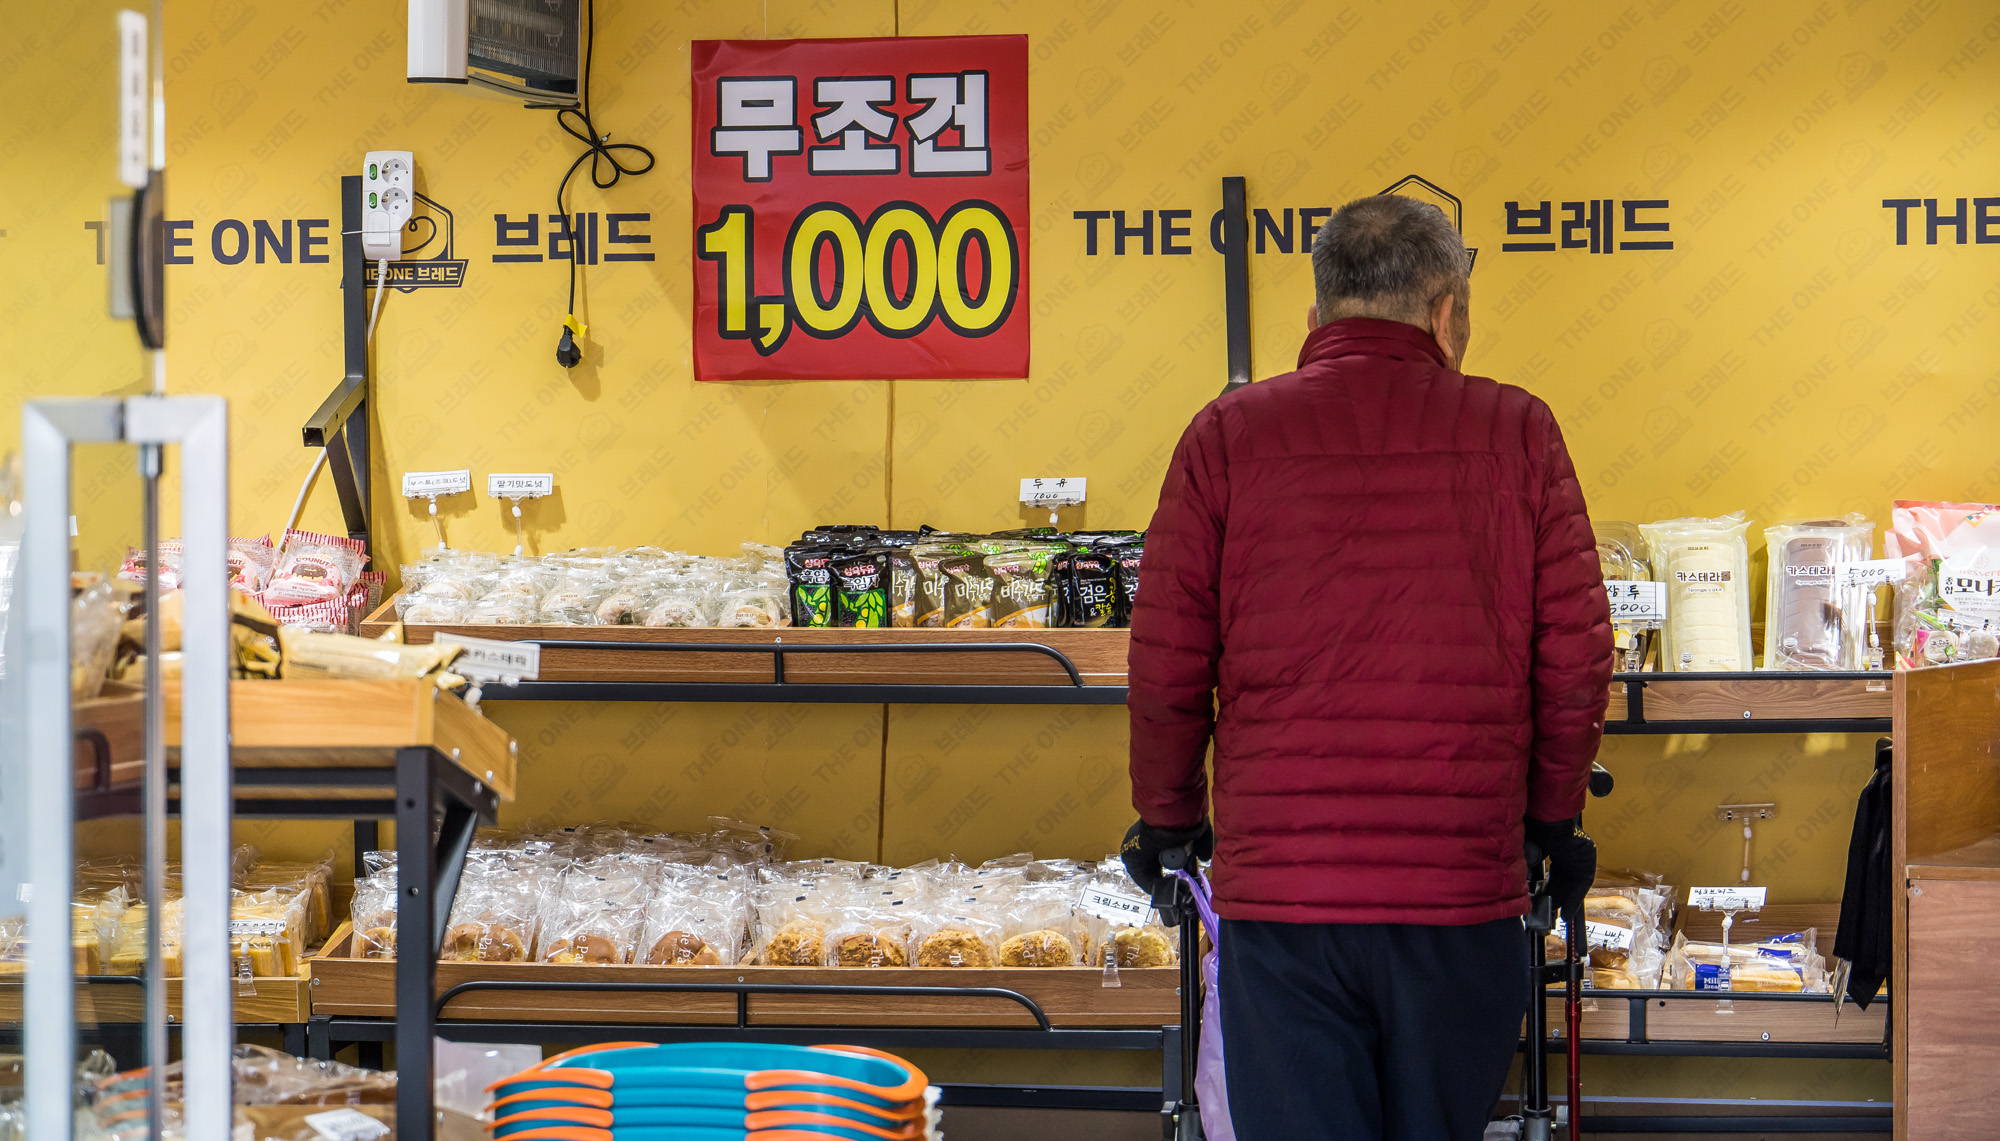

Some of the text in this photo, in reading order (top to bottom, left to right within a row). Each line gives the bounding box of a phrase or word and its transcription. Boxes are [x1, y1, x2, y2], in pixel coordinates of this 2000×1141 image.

[169, 30, 212, 75] ONE
[251, 24, 308, 80] 브레드
[615, 20, 674, 75] 브레드
[1035, 20, 1078, 62] ONE
[1116, 11, 1176, 67] 브레드
[1302, 7, 1363, 64] 브레드
[1365, 10, 1452, 93] THE ONE
[1491, 5, 1553, 61] 브레드
[1555, 6, 1644, 89] THE ONE
[1684, 0, 1746, 56] 브레드
[1749, 3, 1838, 85] THE ONE
[1880, 0, 1941, 52] 브레드
[313, 29, 397, 107] THE ONE
[1177, 15, 1264, 98] THE ONE
[1939, 39, 1985, 80] THE
[251, 108, 308, 164] 브레드
[354, 113, 397, 157] ONE
[435, 107, 492, 163] 브레드
[711, 70, 990, 182] 무조건
[1035, 103, 1078, 148] ONE
[1116, 95, 1175, 153] 브레드
[1177, 102, 1264, 184] THE ONE
[1302, 93, 1363, 151] 브레드
[1365, 97, 1452, 179] THE ONE
[1491, 90, 1553, 148] 브레드
[1556, 93, 1644, 177] THE ONE
[1684, 86, 1746, 144] 브레드
[1749, 90, 1838, 173] THE ONE
[84, 219, 194, 266] TE
[210, 218, 331, 266] ONE
[491, 211, 656, 266] 브레드
[1072, 208, 1192, 256] THE
[1501, 198, 1675, 254] 브레드
[1881, 197, 2000, 246] THE
[417, 267, 459, 281] 브레드
[698, 200, 1019, 355] 1,000
[1492, 264, 1553, 322] 브레드
[1684, 261, 1746, 320] 브레드
[435, 278, 492, 332] 브레드
[1556, 269, 1644, 351] THE ONE
[1749, 266, 1838, 348] THE ONE
[252, 360, 309, 416] 브레드
[436, 359, 493, 416] 브레드
[618, 358, 675, 414] 브레드
[994, 361, 1079, 440] THE ONE
[1116, 353, 1176, 411] 브레드
[1561, 356, 1644, 438] THE ONE
[1684, 349, 1746, 407] 브레드
[1751, 354, 1838, 437] THE ONE
[1880, 348, 1942, 406] 브레드
[495, 402, 538, 443] THE
[678, 400, 721, 442] THE
[811, 402, 854, 441] THE
[1940, 393, 1985, 435] THE
[497, 479, 543, 489] 딸기맛도넛
[619, 445, 676, 499] 브레드
[678, 448, 762, 528] THE ONE
[933, 442, 991, 498] 브레드
[1033, 478, 1067, 490] 두 유
[1600, 446, 1644, 489] ONE
[1685, 441, 1747, 498] 브레드
[1794, 442, 1839, 487] ONE
[1881, 439, 1941, 496] 브레드
[813, 487, 855, 525] THE
[843, 564, 876, 577] 삼육두유
[994, 565, 1020, 575] 삼육두유
[1001, 576, 1046, 603] 미숫가루
[1080, 584, 1107, 604] 검은
[1606, 584, 1640, 601] 상 투
[1090, 607, 1097, 617] &
[537, 706, 581, 748] ONE
[619, 702, 679, 754] 브레드
[681, 706, 766, 783] THE ONE
[934, 704, 993, 757] 브레드
[994, 707, 1080, 786] THE ONE
[812, 744, 856, 783] THE
[933, 785, 993, 843] 브레드
[1036, 791, 1080, 834] ONE
[1795, 800, 1841, 842] ONE
[478, 937, 493, 959] Pan
[1126, 945, 1140, 967] The
